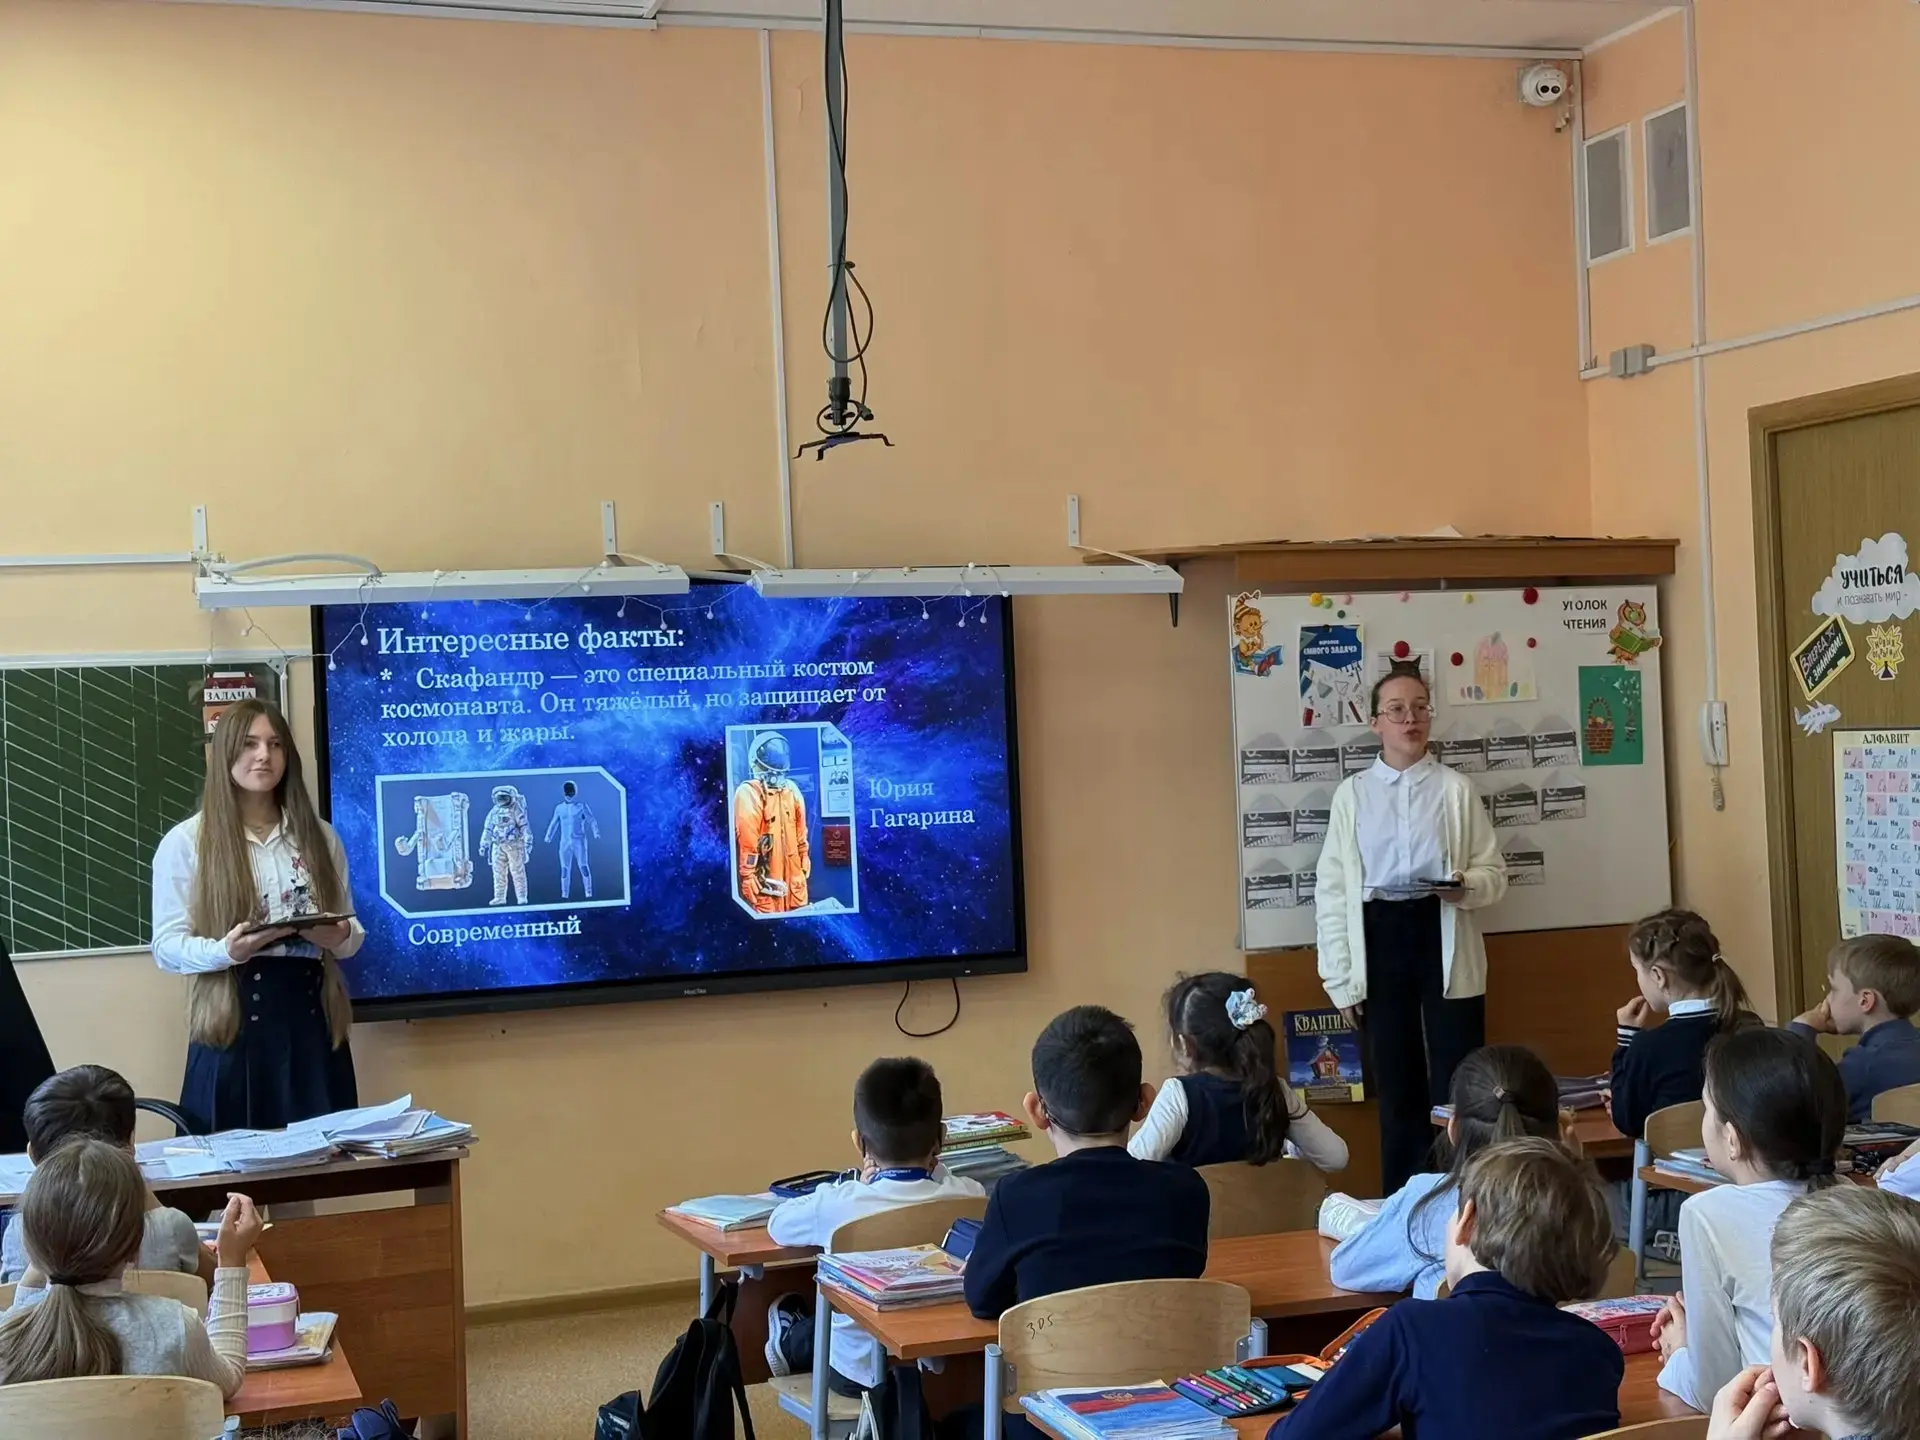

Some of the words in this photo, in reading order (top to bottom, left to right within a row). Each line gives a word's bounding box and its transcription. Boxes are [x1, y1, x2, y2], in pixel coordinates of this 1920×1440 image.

[1840, 564, 1904, 590] УЧИТЬСЯ
[1844, 593, 1882, 606] познавать
[1885, 591, 1901, 606] мир
[1563, 618, 1607, 630] ЧТЕНИЯ
[376, 627, 569, 658] Интересные
[578, 623, 685, 654] факты:
[1813, 633, 1844, 681] ЗНАНИЯМ!
[416, 666, 544, 691] Скафандр
[584, 668, 621, 684] это
[627, 660, 787, 684] специальный
[793, 660, 875, 678] костюм
[381, 697, 532, 720] космонавта.
[540, 692, 577, 713] Он
[582, 690, 697, 713] тяжёлый,
[705, 692, 733, 708] но
[739, 688, 857, 707] защищает
[863, 686, 887, 703] от
[382, 729, 469, 748] холода
[477, 729, 493, 744] и
[500, 725, 576, 745] жары.
[1862, 733, 1909, 744] АЛФАВИТ
[869, 777, 935, 801] Юрия
[870, 807, 976, 830] Гагарина
[408, 916, 582, 948] Современный
